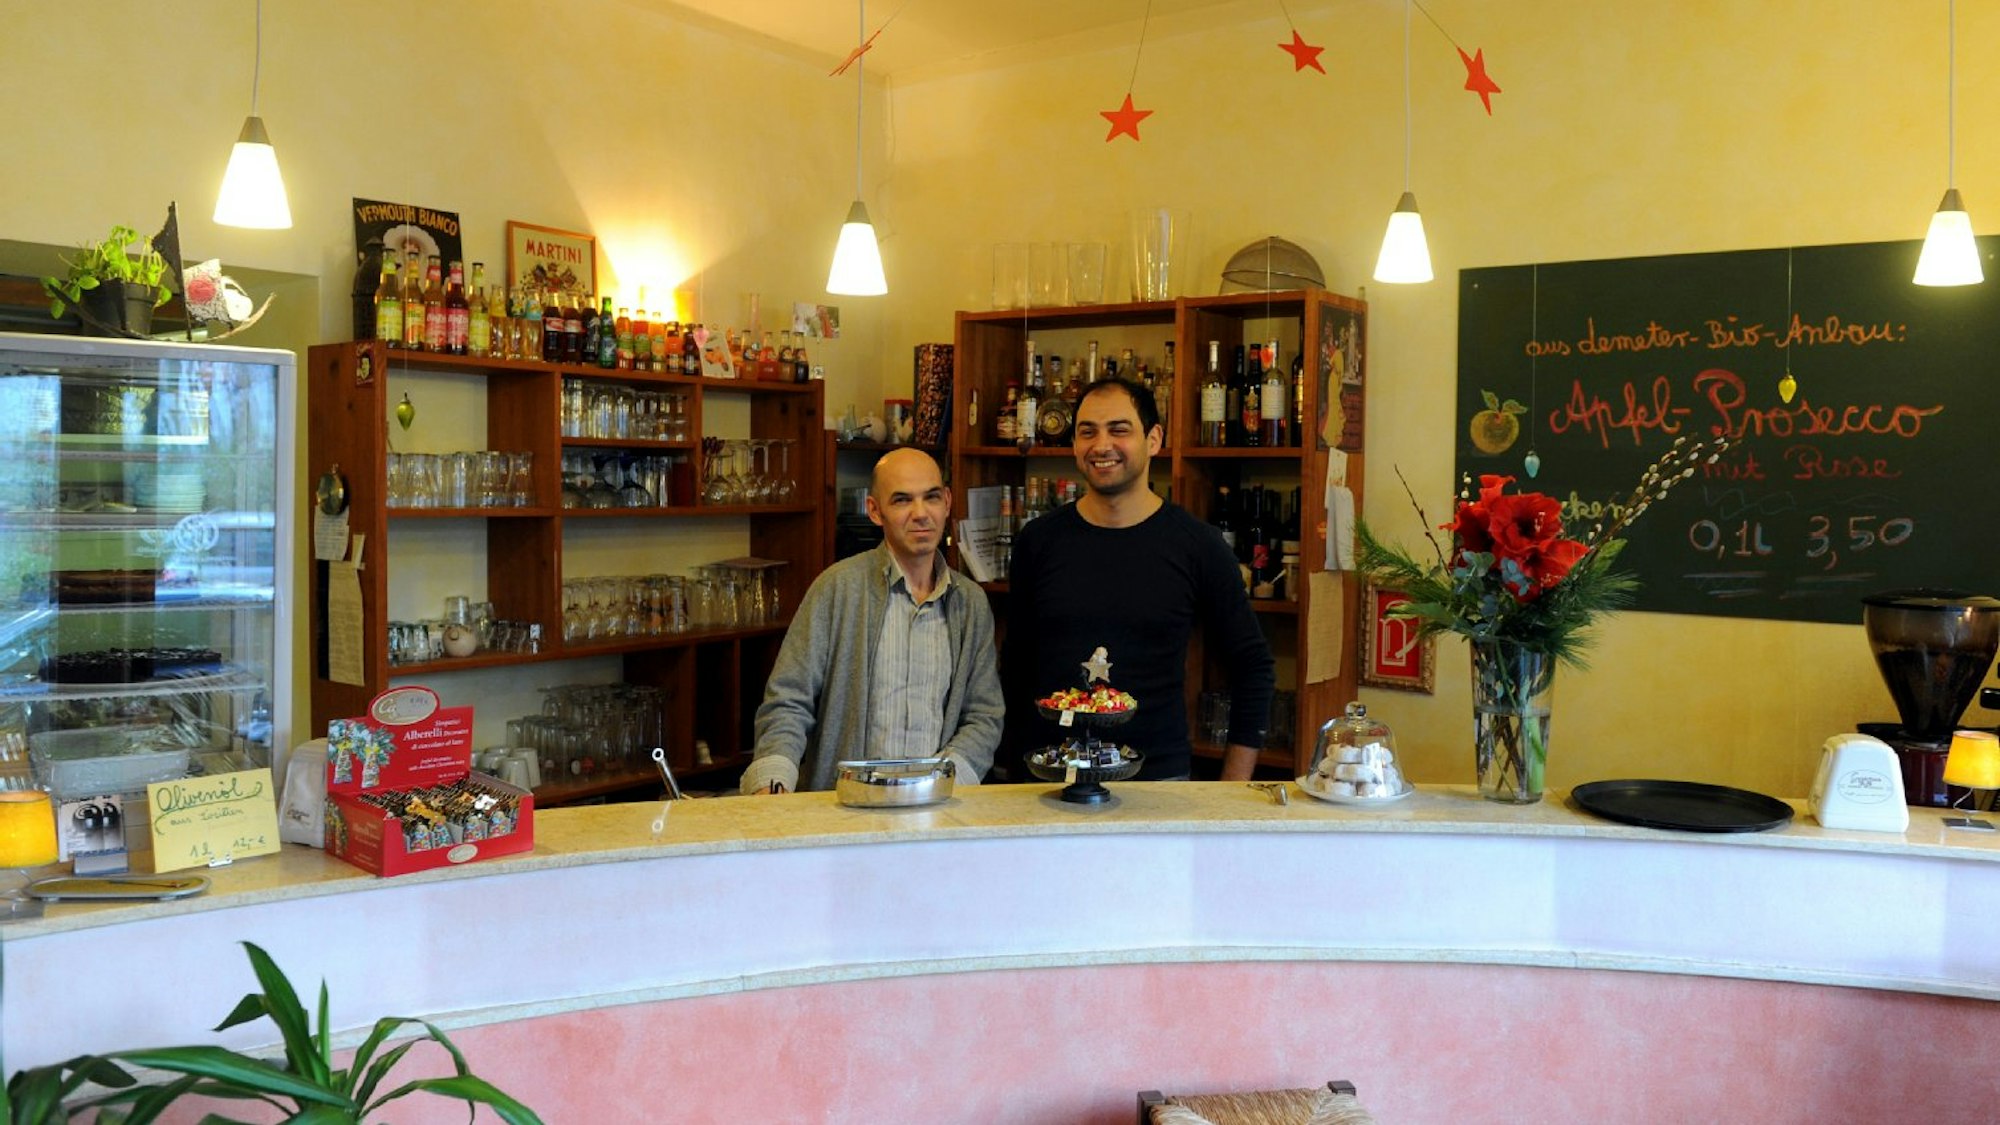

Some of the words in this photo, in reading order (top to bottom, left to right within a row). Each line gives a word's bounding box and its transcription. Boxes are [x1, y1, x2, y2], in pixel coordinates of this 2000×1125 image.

[356, 203, 416, 225] VERMOUTH
[418, 208, 458, 236] BIANCO
[525, 237, 583, 264] MARTINI
[1525, 339, 1570, 356] aus
[1702, 451, 1767, 480] mit
[1806, 515, 1914, 570] 3,50
[402, 728, 443, 742] Alberelli
[156, 777, 248, 814] Olivenöl
